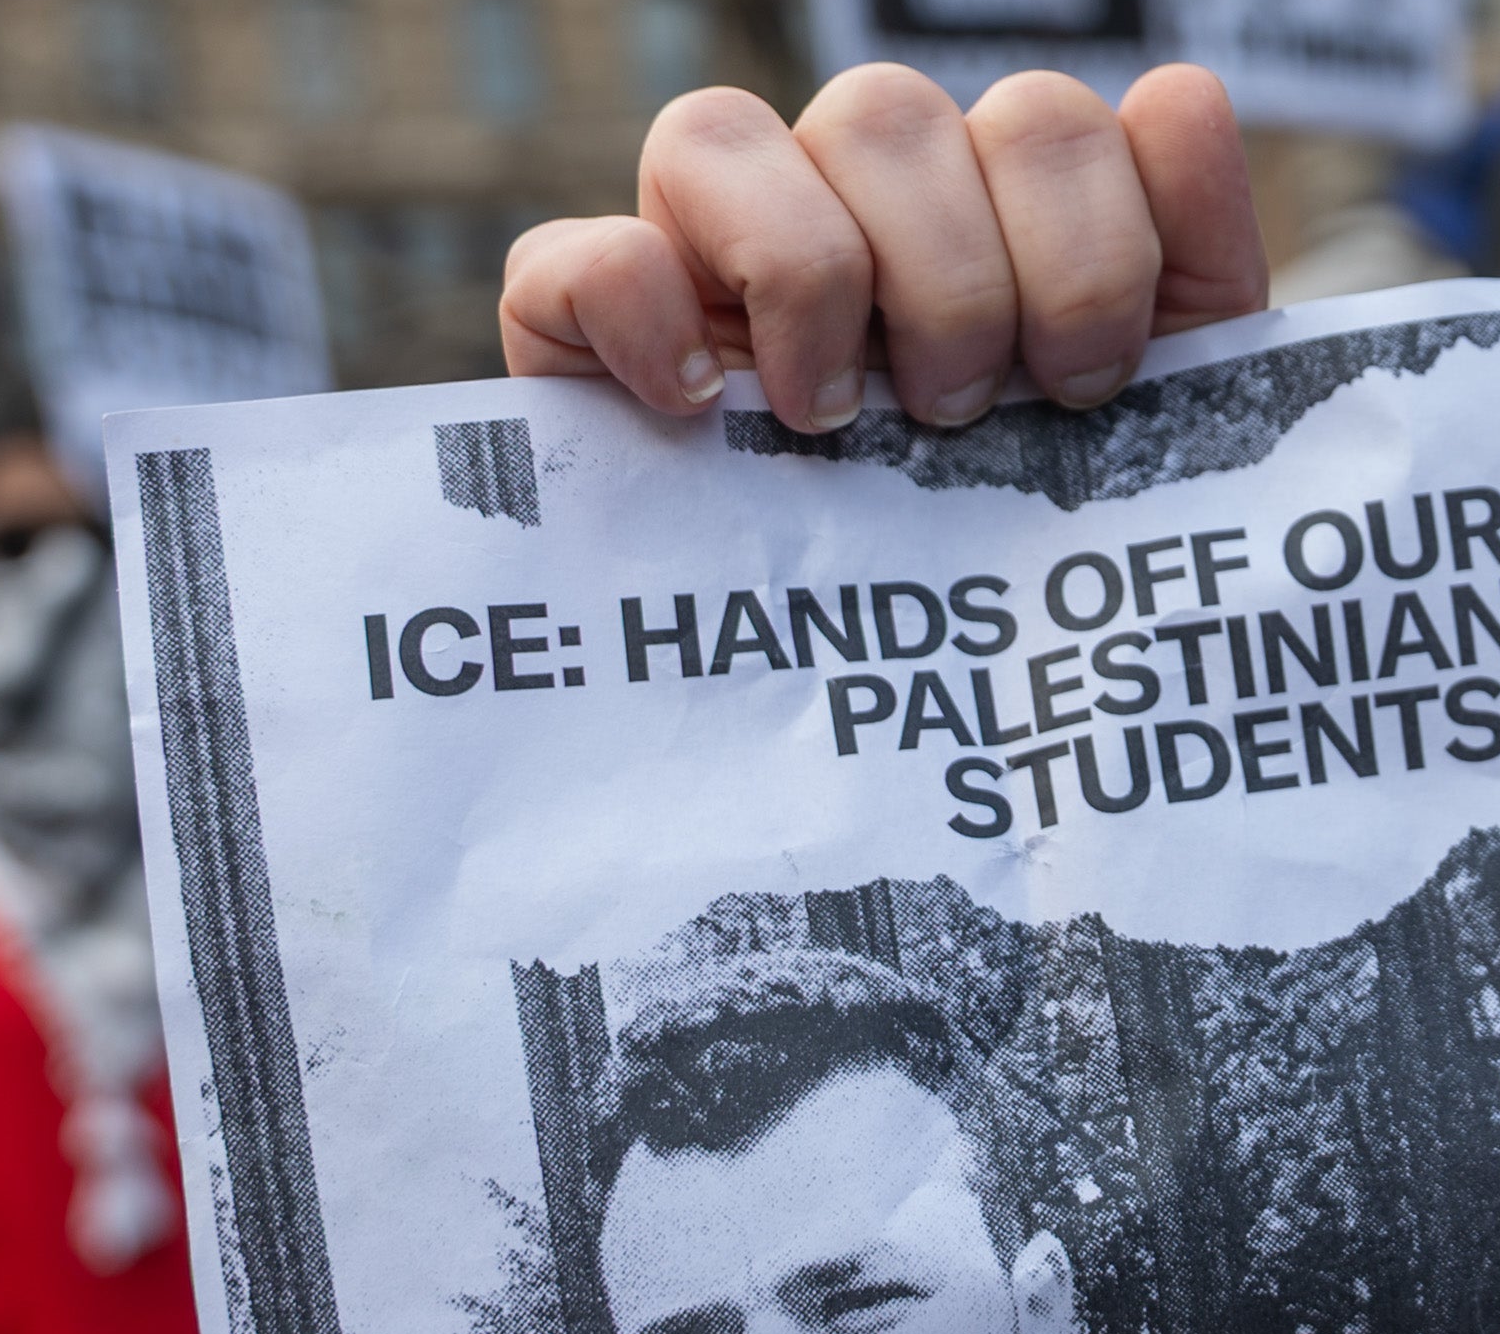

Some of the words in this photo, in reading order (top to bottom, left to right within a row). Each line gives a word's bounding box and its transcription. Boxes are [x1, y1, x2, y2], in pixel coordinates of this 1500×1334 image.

[363, 601, 585, 701] ICE:
[620, 575, 1019, 683] HANDS
[1044, 528, 1249, 632] OFF
